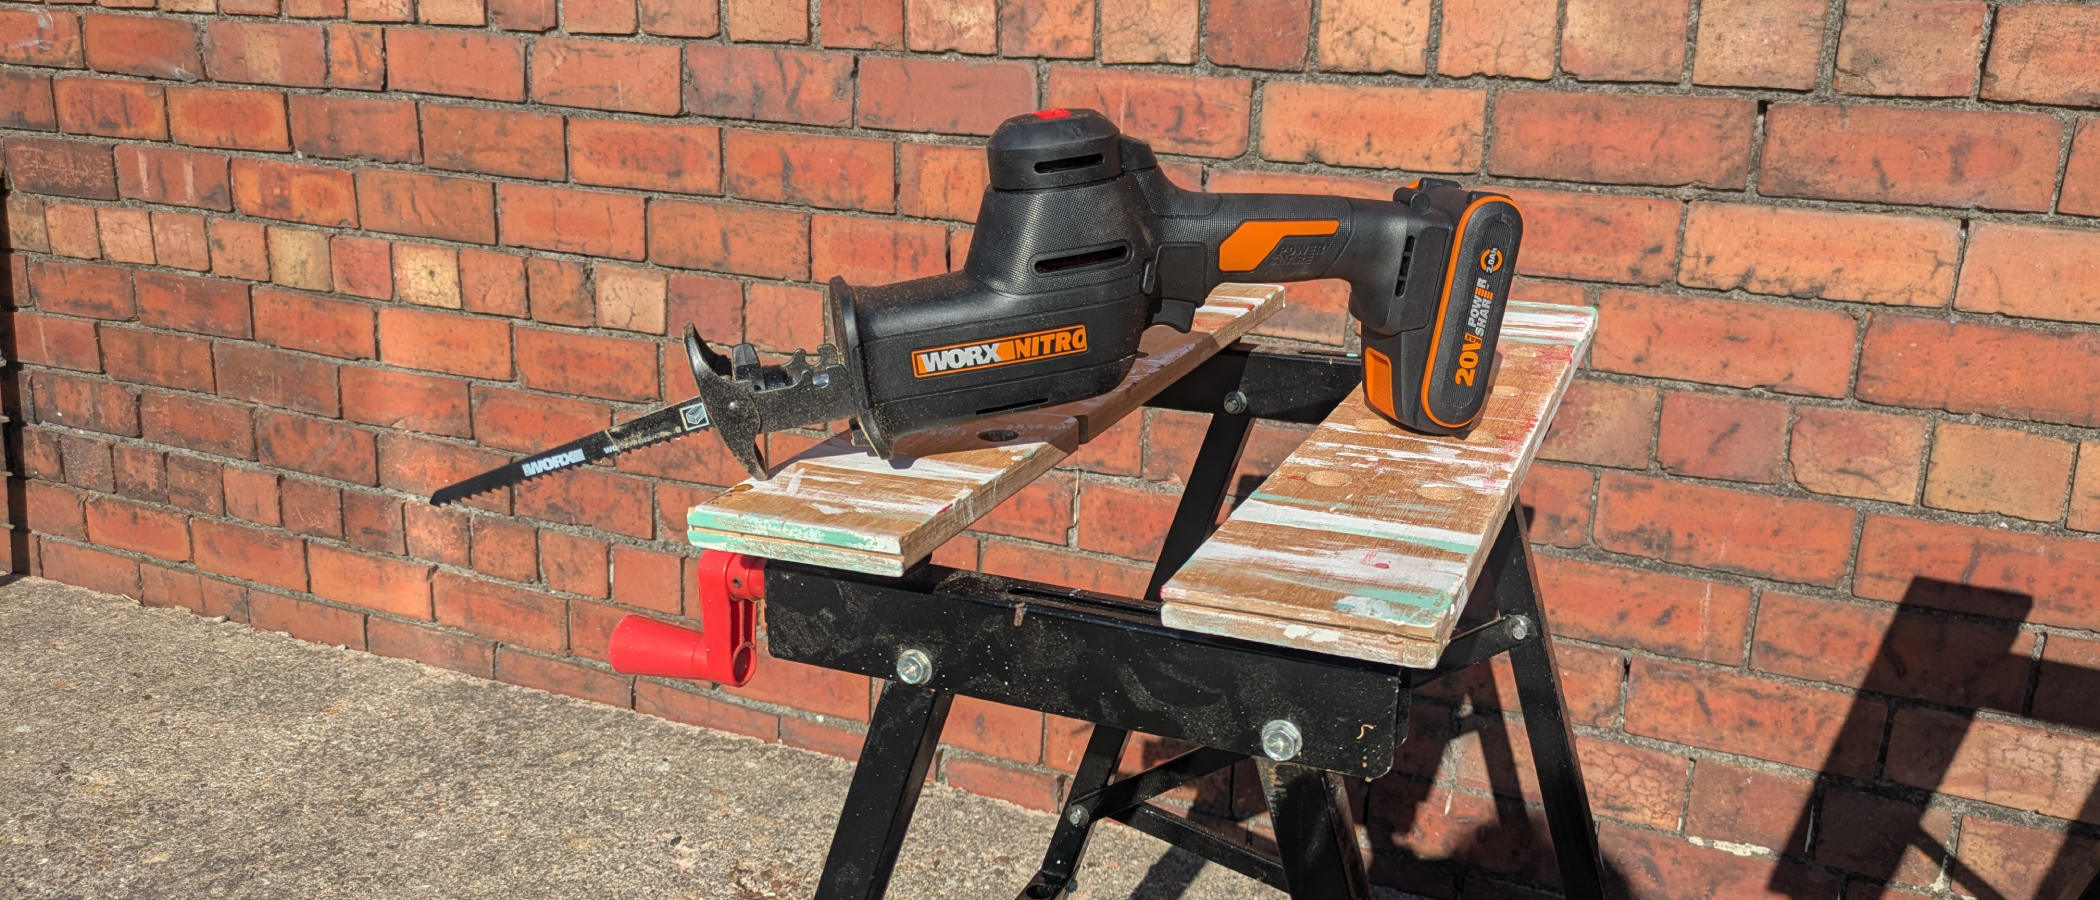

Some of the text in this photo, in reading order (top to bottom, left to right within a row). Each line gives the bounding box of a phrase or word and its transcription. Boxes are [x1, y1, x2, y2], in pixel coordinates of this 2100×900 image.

[1486, 247, 1498, 274] 2.0Ah
[1467, 277, 1487, 328] POWER
[1475, 291, 1494, 337] SHARE
[920, 328, 1087, 373] WORX NITRO
[1455, 333, 1483, 387] 20V
[1465, 334, 1482, 344] MAX
[523, 448, 583, 477] WORX
